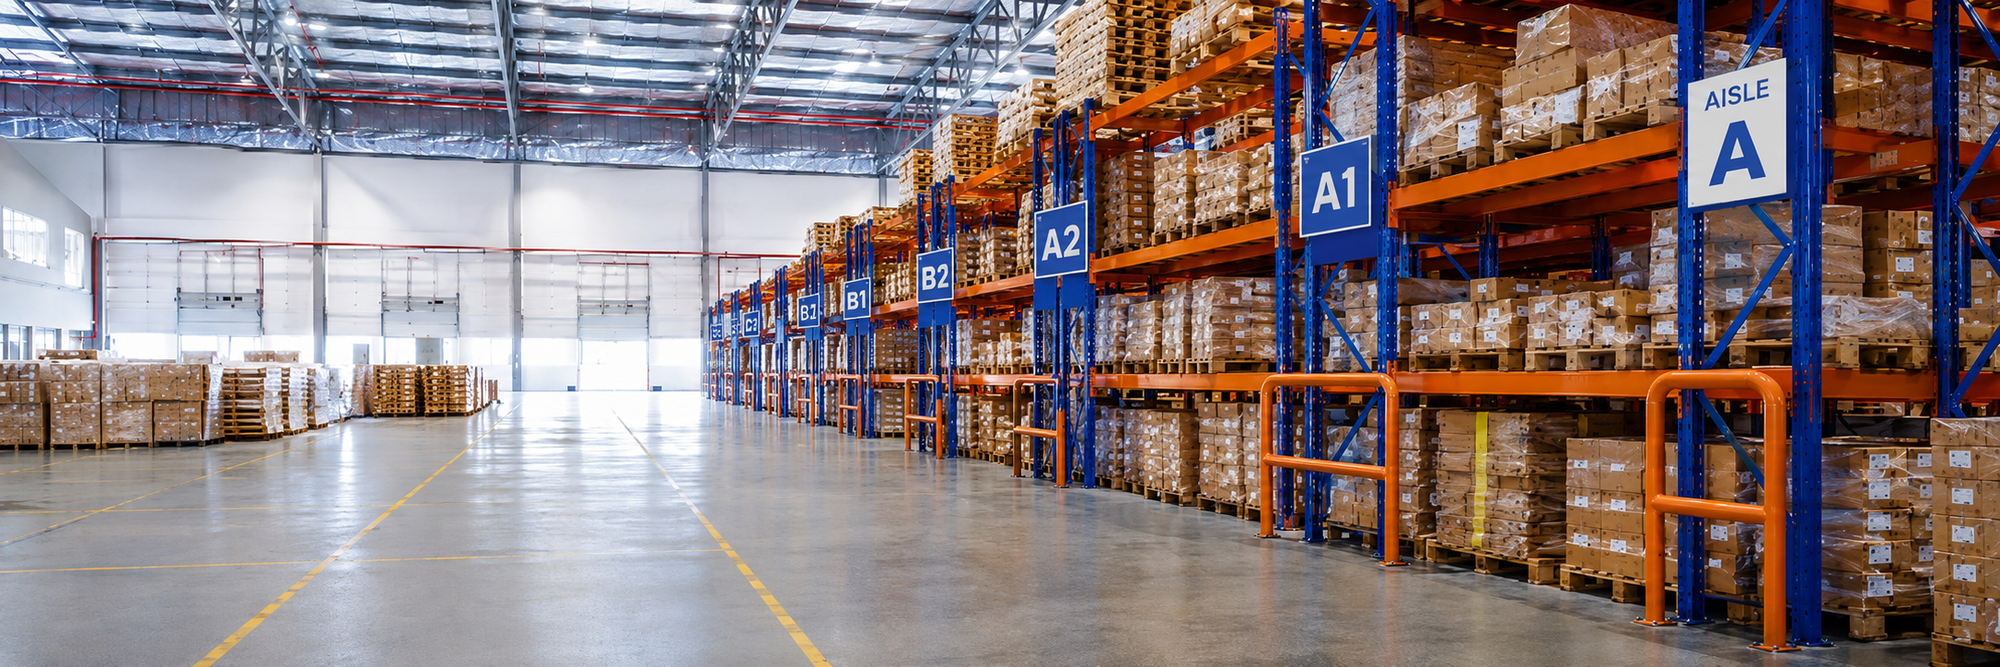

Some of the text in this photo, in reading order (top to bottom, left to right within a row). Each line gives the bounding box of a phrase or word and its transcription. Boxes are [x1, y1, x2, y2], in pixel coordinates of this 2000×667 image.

[1704, 78, 1770, 111] AISLE
[1709, 120, 1766, 187] A
[1312, 166, 1355, 214] A1
[1041, 224, 1080, 261] A2
[922, 263, 949, 291] B2
[847, 290, 866, 310] B1
